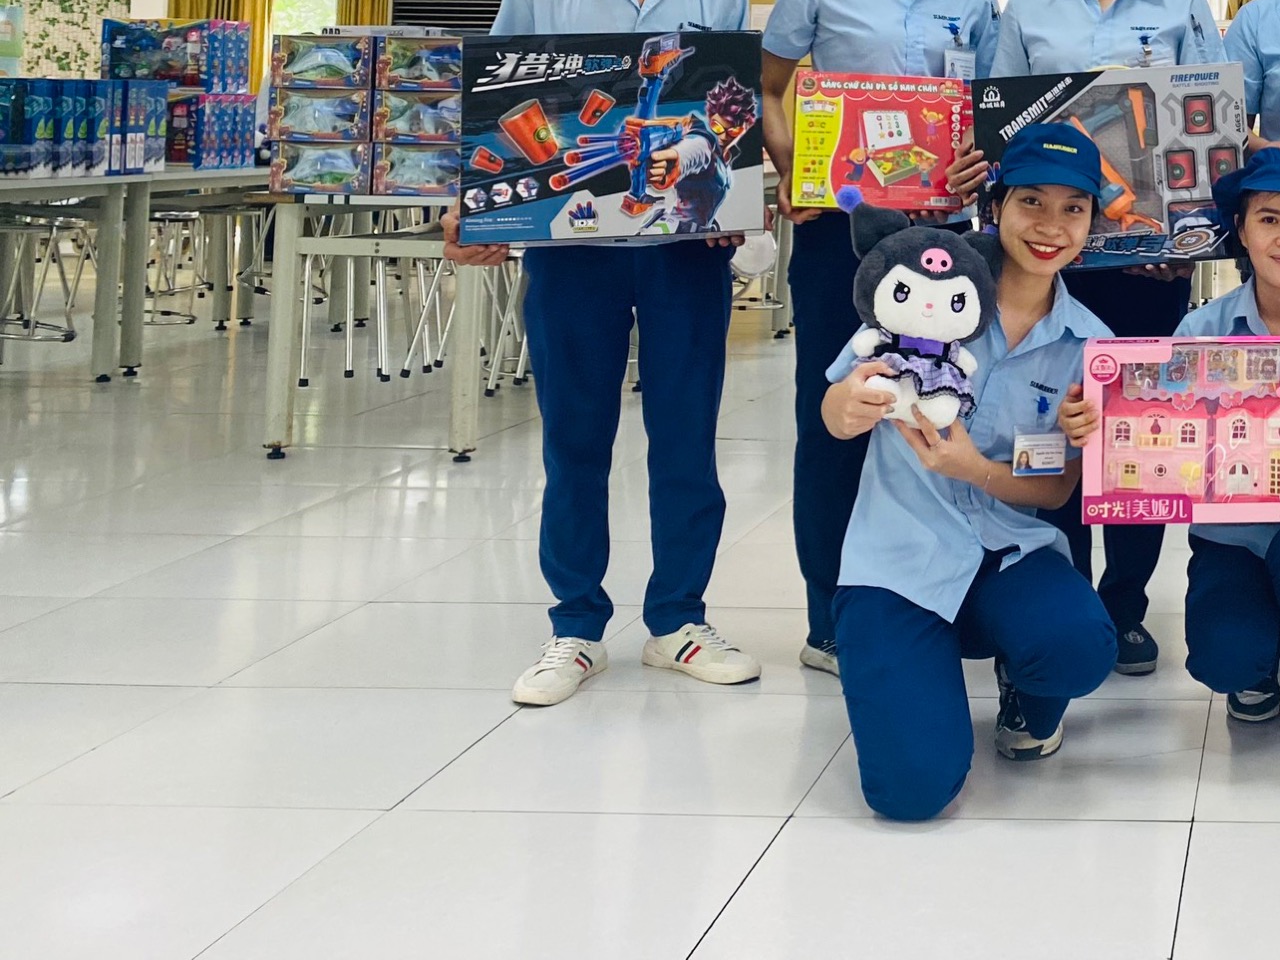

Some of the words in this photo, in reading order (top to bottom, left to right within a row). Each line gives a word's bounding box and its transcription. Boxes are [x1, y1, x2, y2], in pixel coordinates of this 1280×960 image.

[1170, 72, 1220, 83] FIREPOWER
[999, 96, 1049, 141] TRANSMIT
[1234, 113, 1242, 133] AGES
